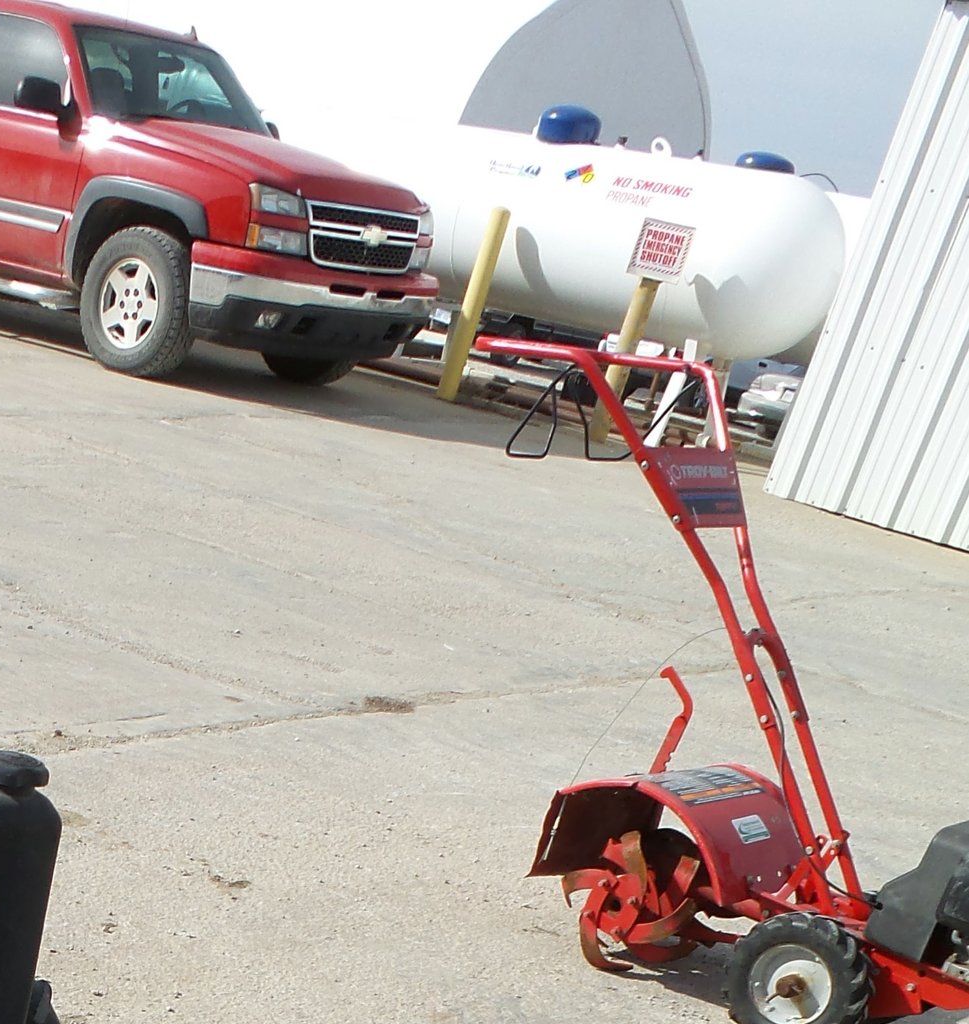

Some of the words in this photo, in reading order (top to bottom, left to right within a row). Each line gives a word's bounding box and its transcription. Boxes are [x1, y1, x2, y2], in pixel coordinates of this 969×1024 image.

[612, 176, 633, 188] NO
[633, 179, 693, 198] SMOKING
[606, 190, 654, 207] PROPANE
[645, 228, 686, 247] PROPANE
[640, 250, 678, 267] SHUTOFF
